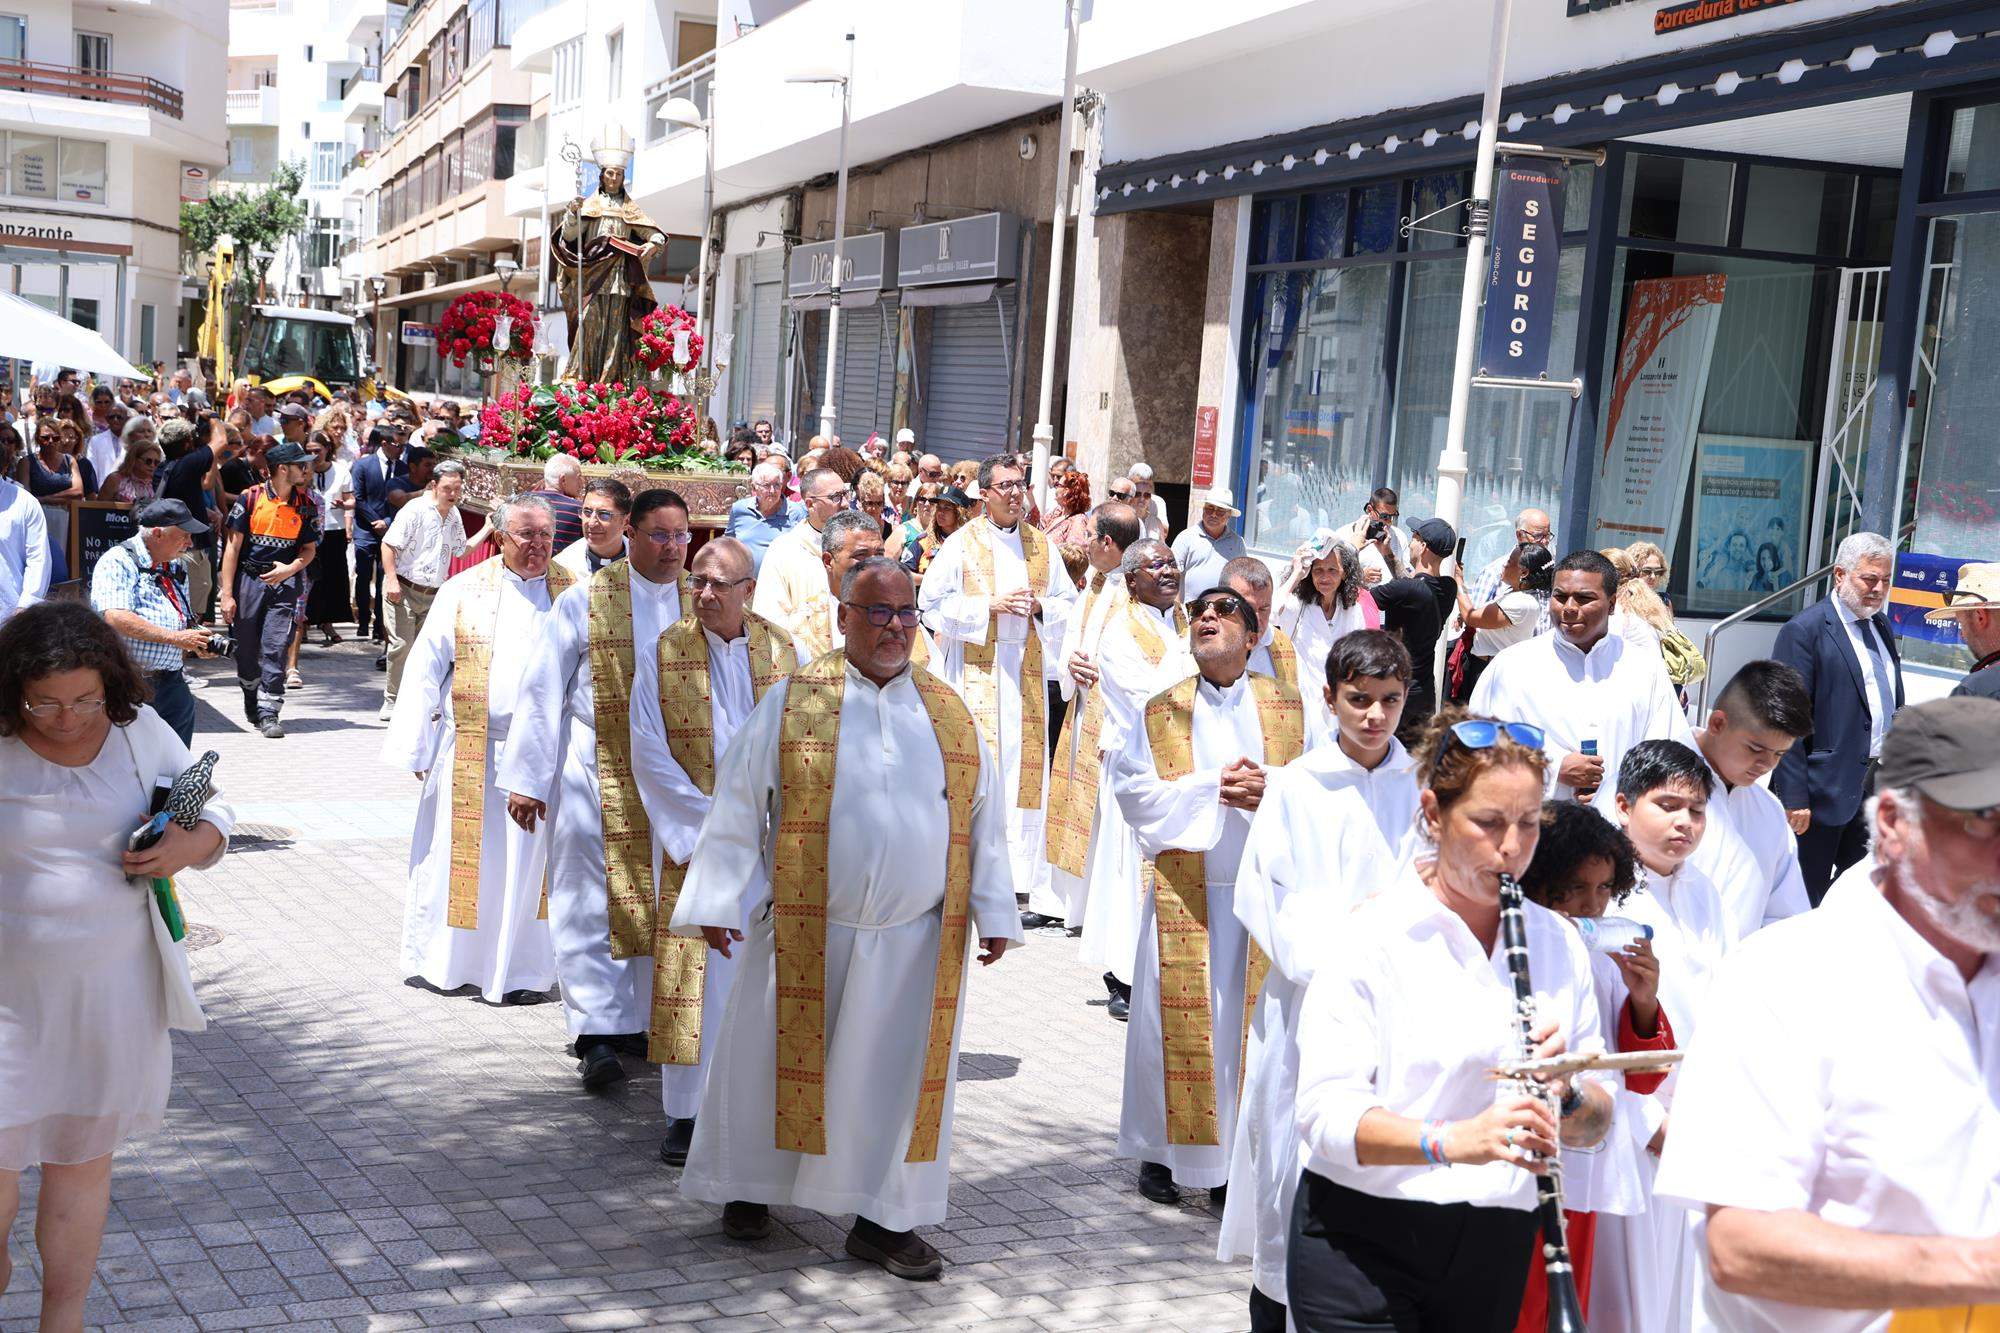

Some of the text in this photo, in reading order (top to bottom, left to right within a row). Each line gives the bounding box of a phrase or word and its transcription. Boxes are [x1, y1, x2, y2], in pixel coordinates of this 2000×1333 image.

[810, 252, 853, 284] D'Caro
[1508, 200, 1540, 357] SEGUROS
[1663, 372, 1679, 380] Broker
[86, 536, 101, 548] NO
[1902, 570, 1918, 579] Allianz
